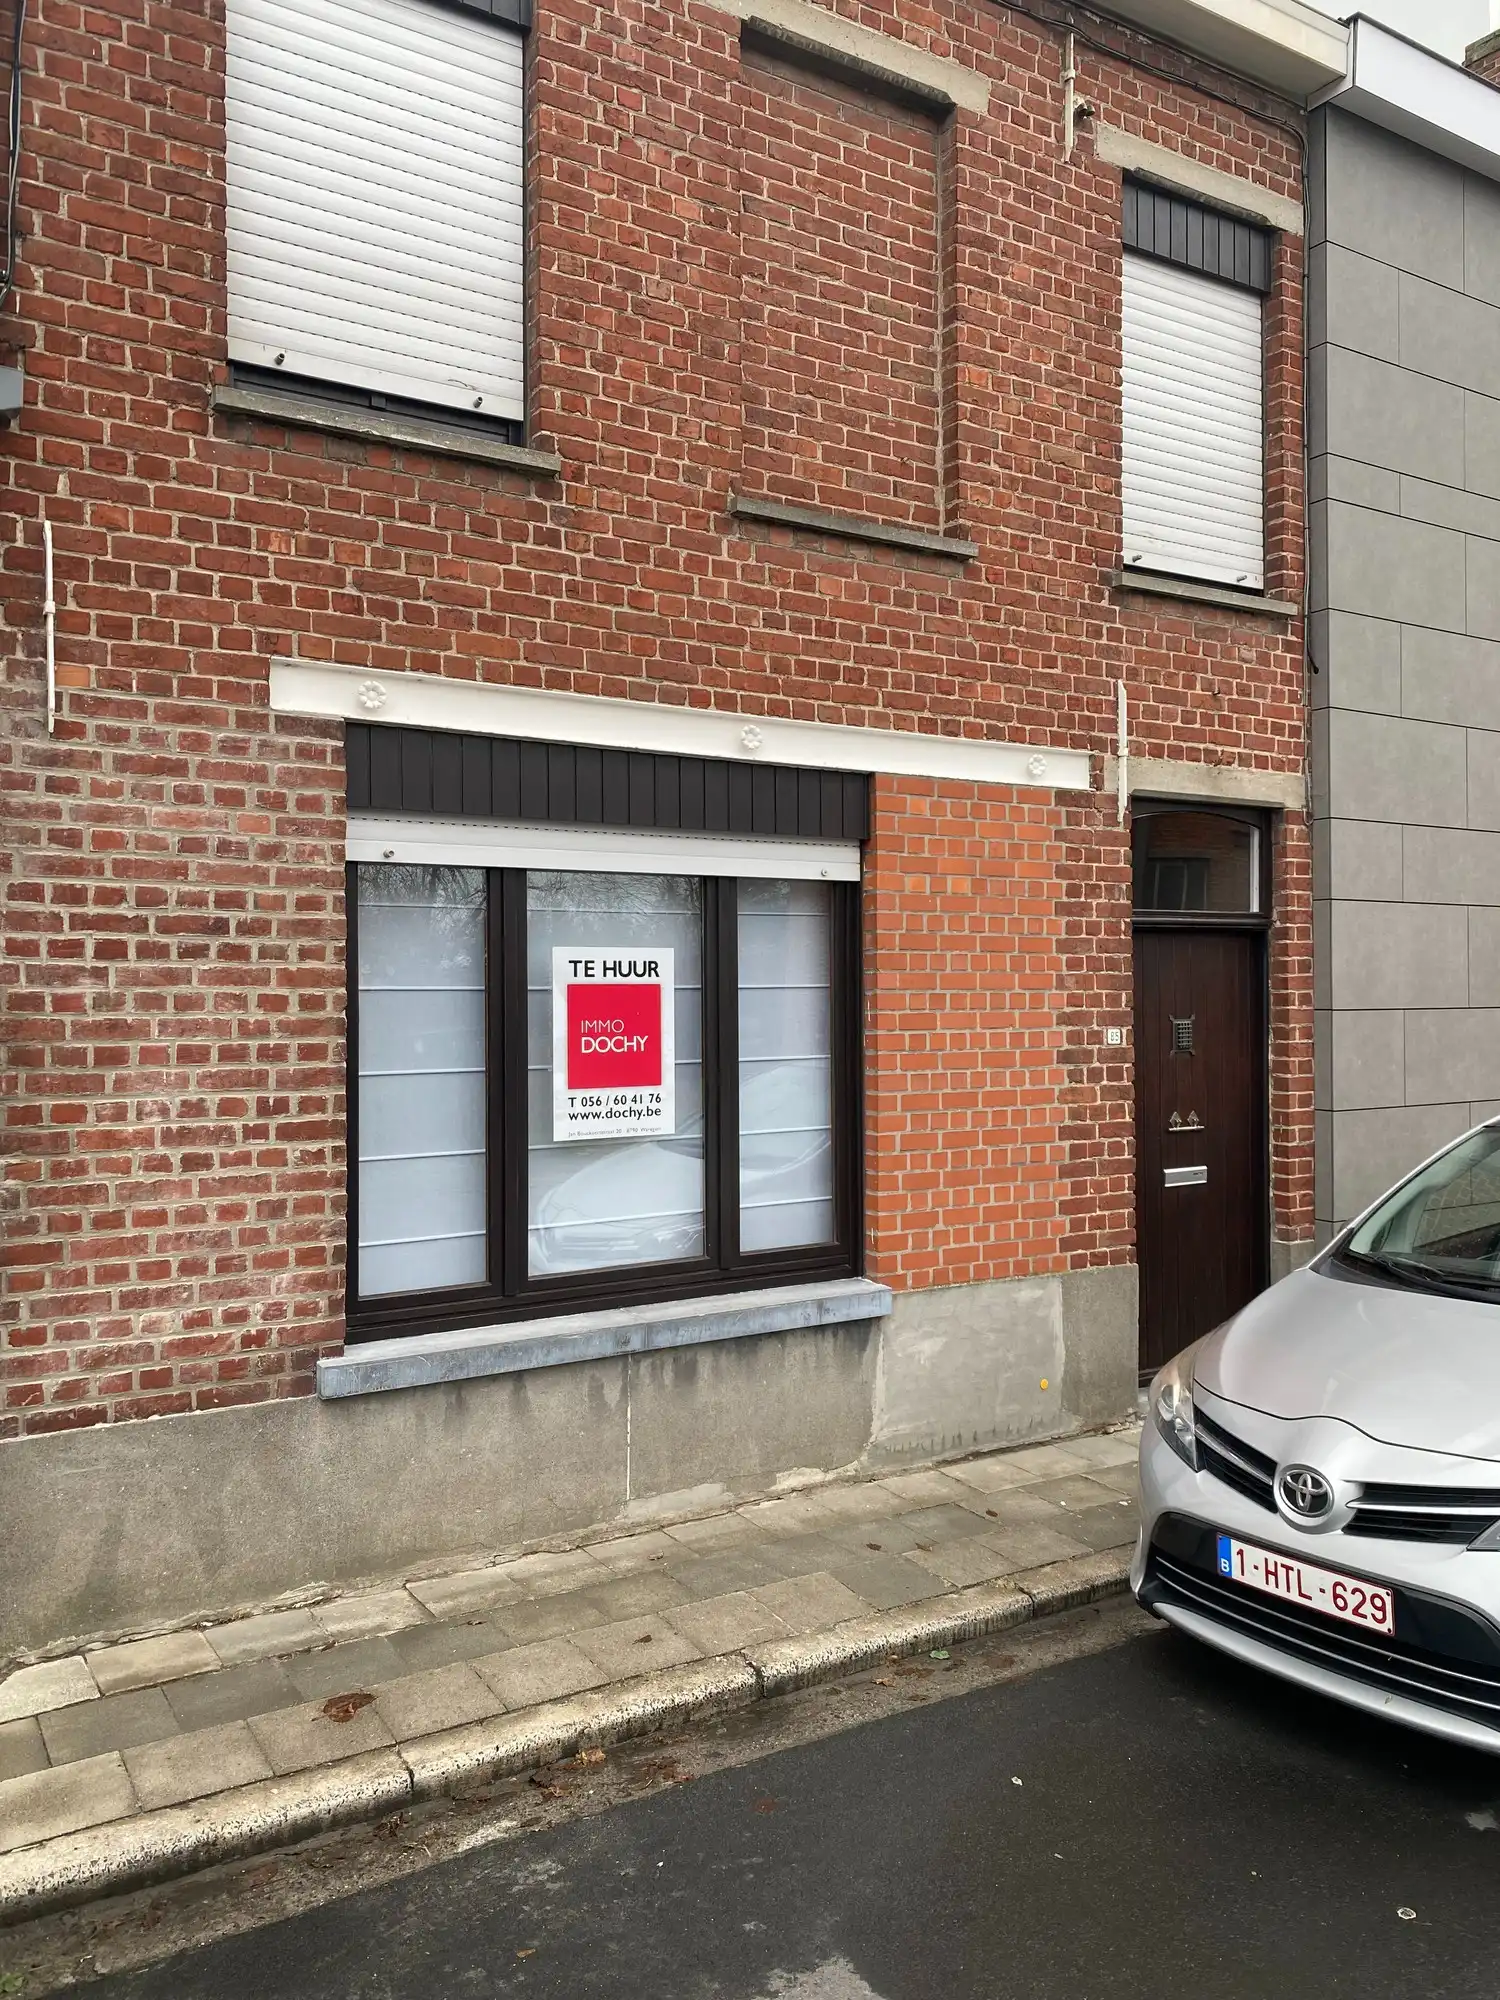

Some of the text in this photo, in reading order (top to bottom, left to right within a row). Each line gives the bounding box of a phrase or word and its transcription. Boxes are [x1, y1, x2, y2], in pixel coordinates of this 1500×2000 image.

[568, 960, 660, 977] TE HUUR
[581, 1019, 625, 1033] IMMO
[581, 1035, 648, 1053] DOCHY
[568, 1097, 577, 1108] T
[581, 1095, 602, 1107] 056
[613, 1094, 627, 1105] 60
[631, 1093, 643, 1104] 41
[648, 1093, 662, 1103] 76
[568, 1105, 662, 1121] www.dochy.be
[1220, 1547, 1388, 1625] B 1-HTL-629
